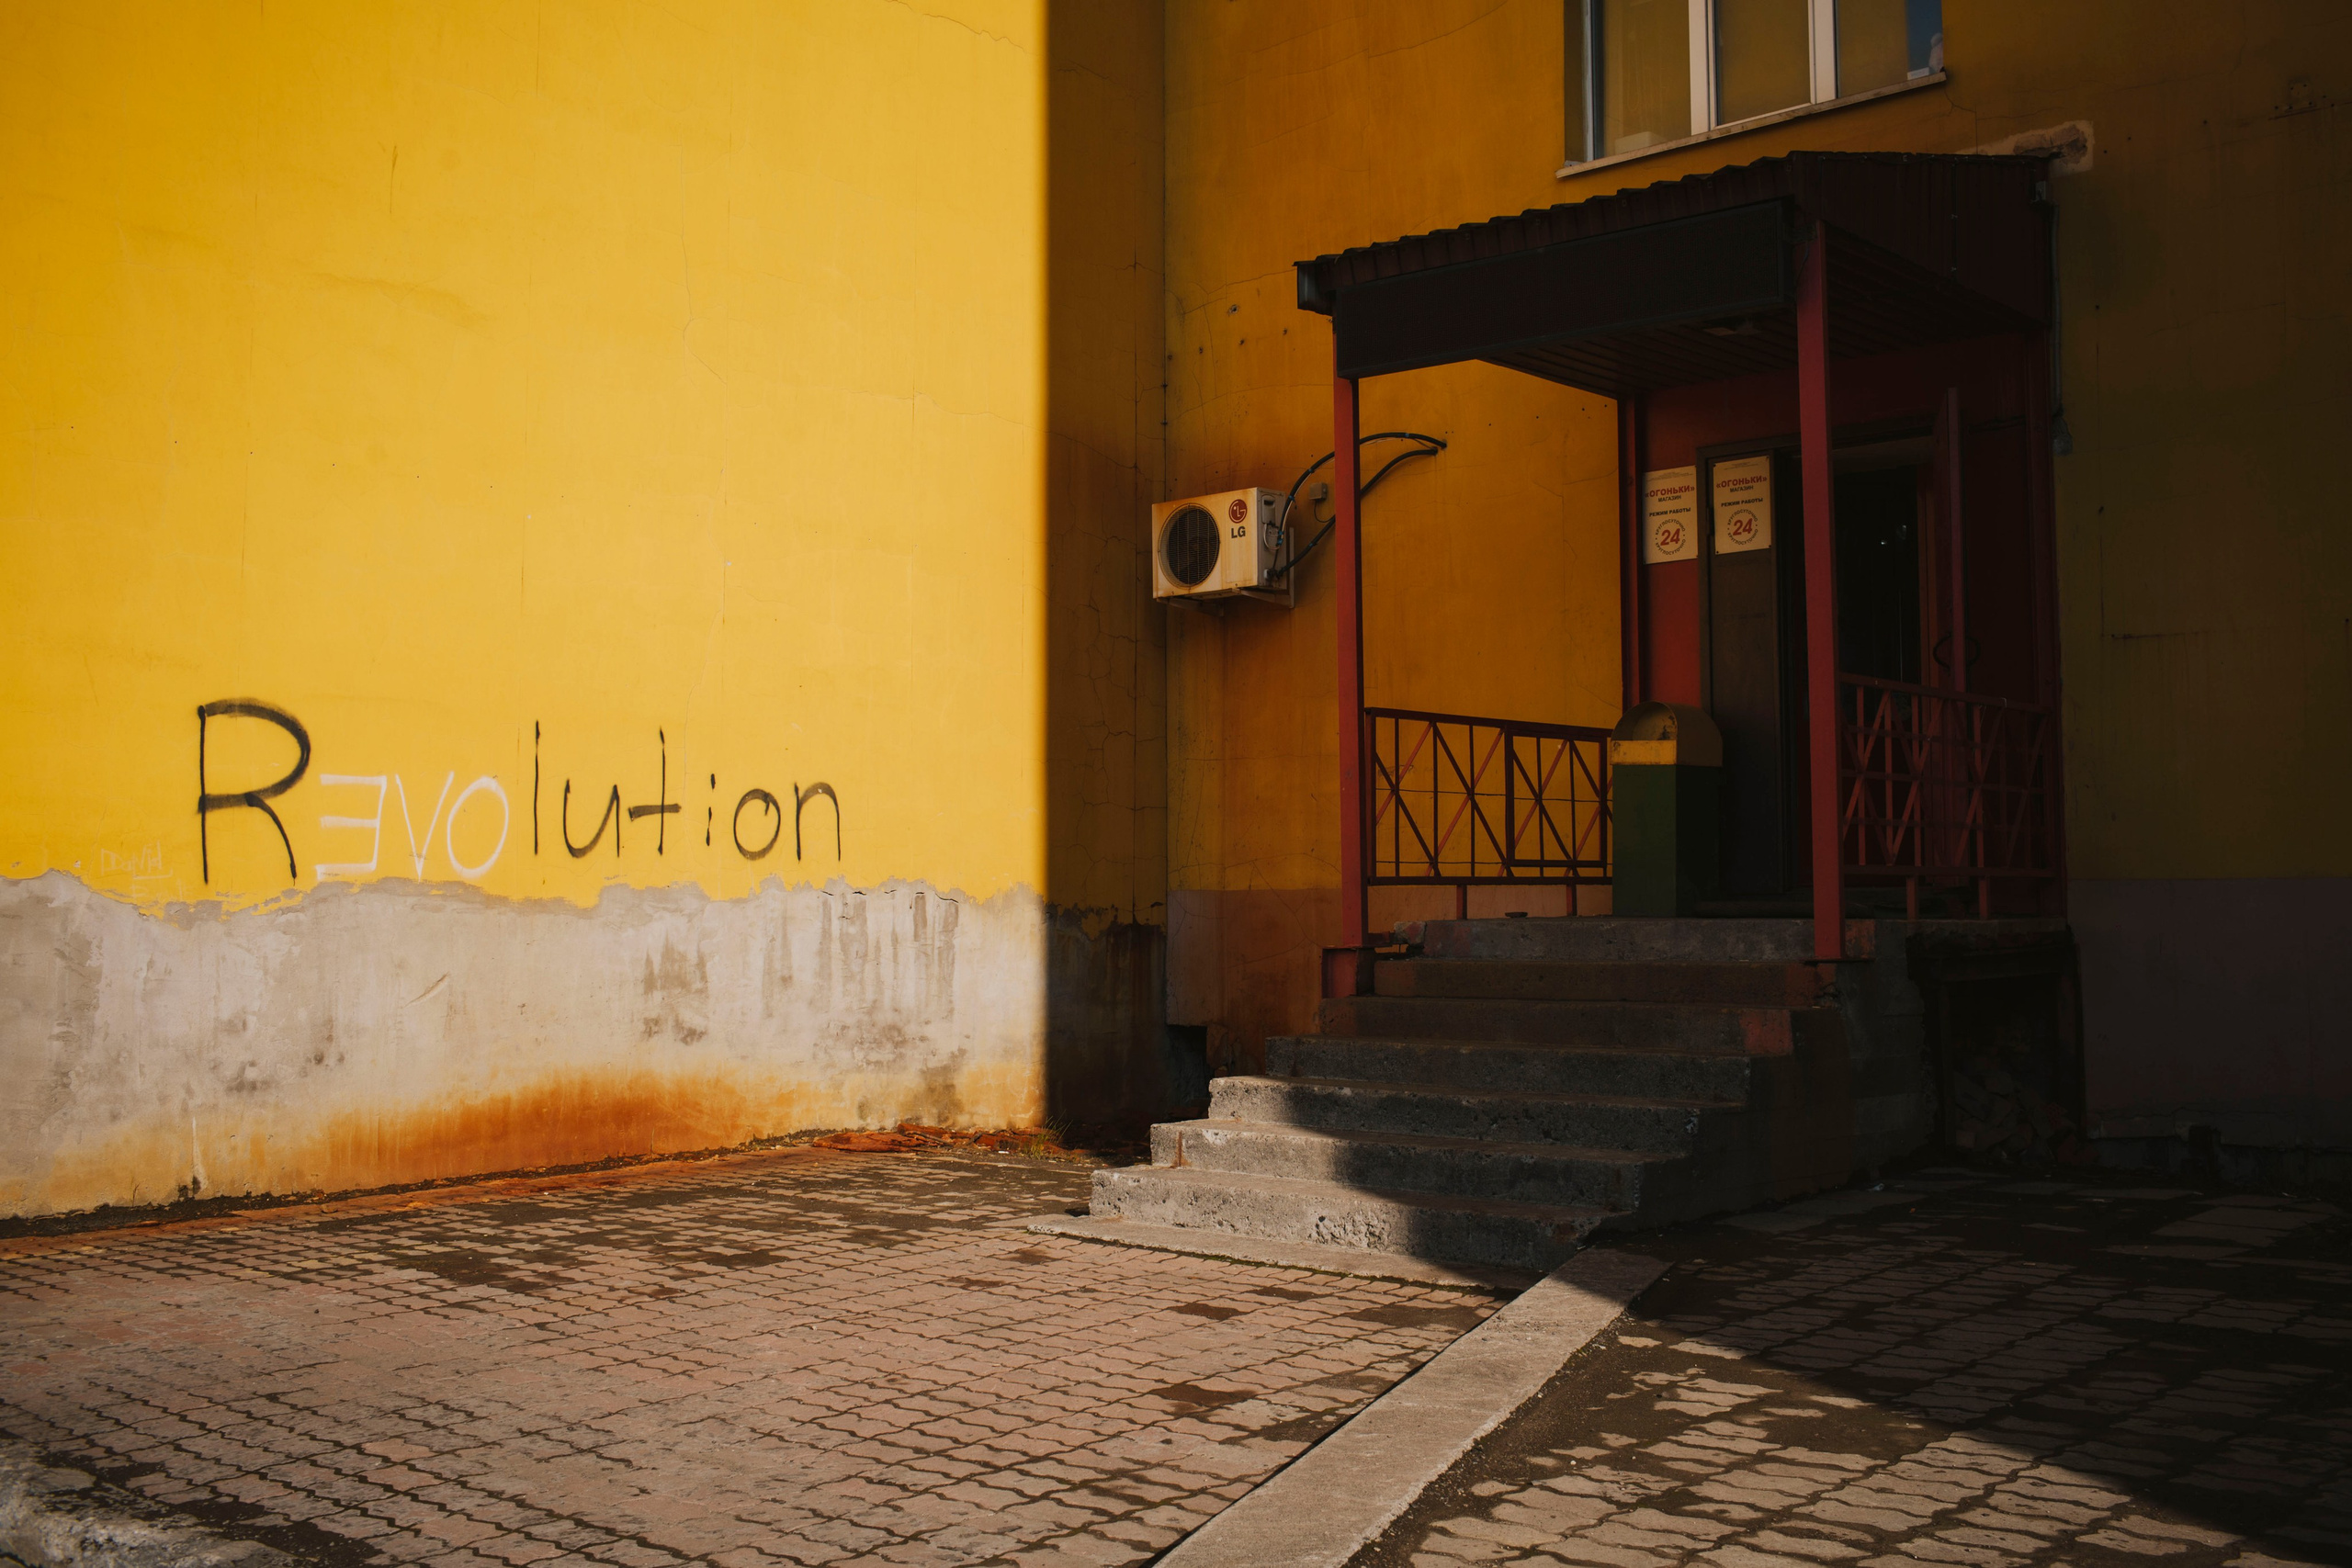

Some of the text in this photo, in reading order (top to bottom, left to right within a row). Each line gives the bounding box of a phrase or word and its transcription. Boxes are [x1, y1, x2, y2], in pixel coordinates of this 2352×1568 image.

[1715, 475, 1768, 489] «ОГОНЬКИ»
[1729, 485, 1754, 493] МАГАЗИН
[1645, 485, 1695, 498] «ОГОНЬКИ»
[1741, 497, 1763, 505] РАБОТЫ
[1727, 508, 1758, 525] КРУГЛОСУТОЧНО
[1231, 525, 1246, 539] LG
[1655, 518, 1686, 536] КРУГЛОСУТОЧНО
[1733, 517, 1753, 536] 24
[1660, 527, 1680, 547] 24
[1727, 528, 1758, 546] КРУГЛОСУТОЧНО
[1655, 538, 1686, 556] КРУГЛОСУТОЧНО
